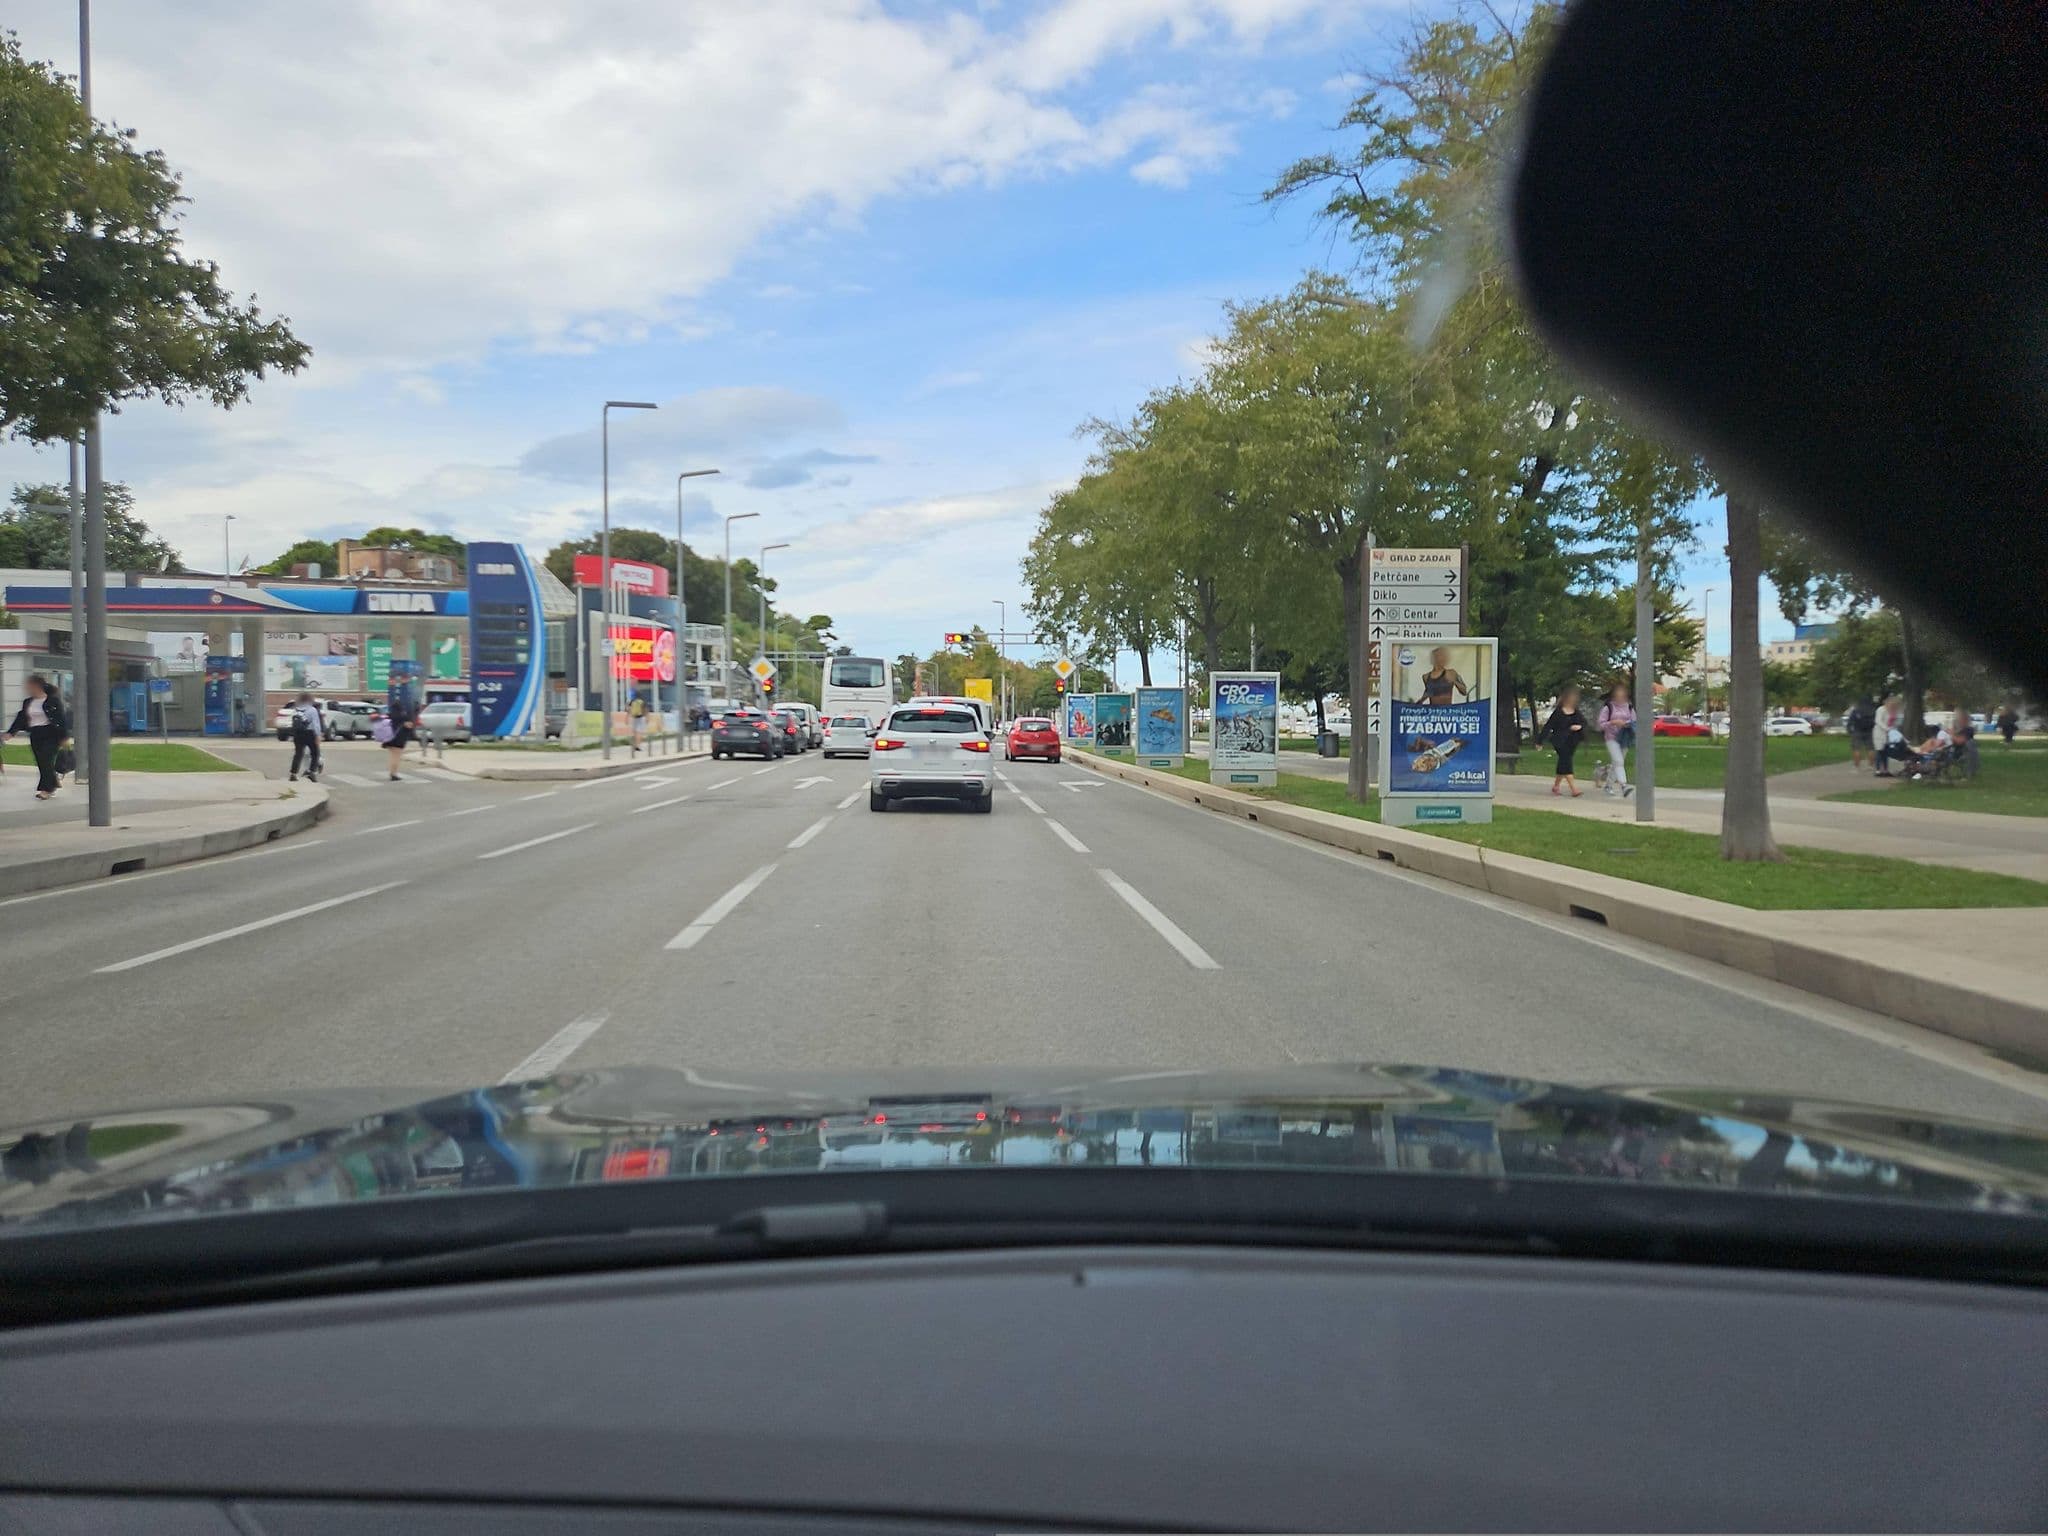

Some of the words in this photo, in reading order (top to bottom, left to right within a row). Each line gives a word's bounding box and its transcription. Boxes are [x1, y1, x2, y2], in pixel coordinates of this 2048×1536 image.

[1373, 571, 1420, 582] Petrčane
[1373, 590, 1398, 600] Diklo
[1403, 608, 1438, 619] Centar
[1219, 684, 1250, 696] CRO
[1226, 694, 1265, 705] RACE
[1400, 722, 1405, 734] I
[1406, 722, 1457, 734] ZABAVI
[1460, 722, 1480, 734] SE!
[1467, 770, 1486, 779] kcal
